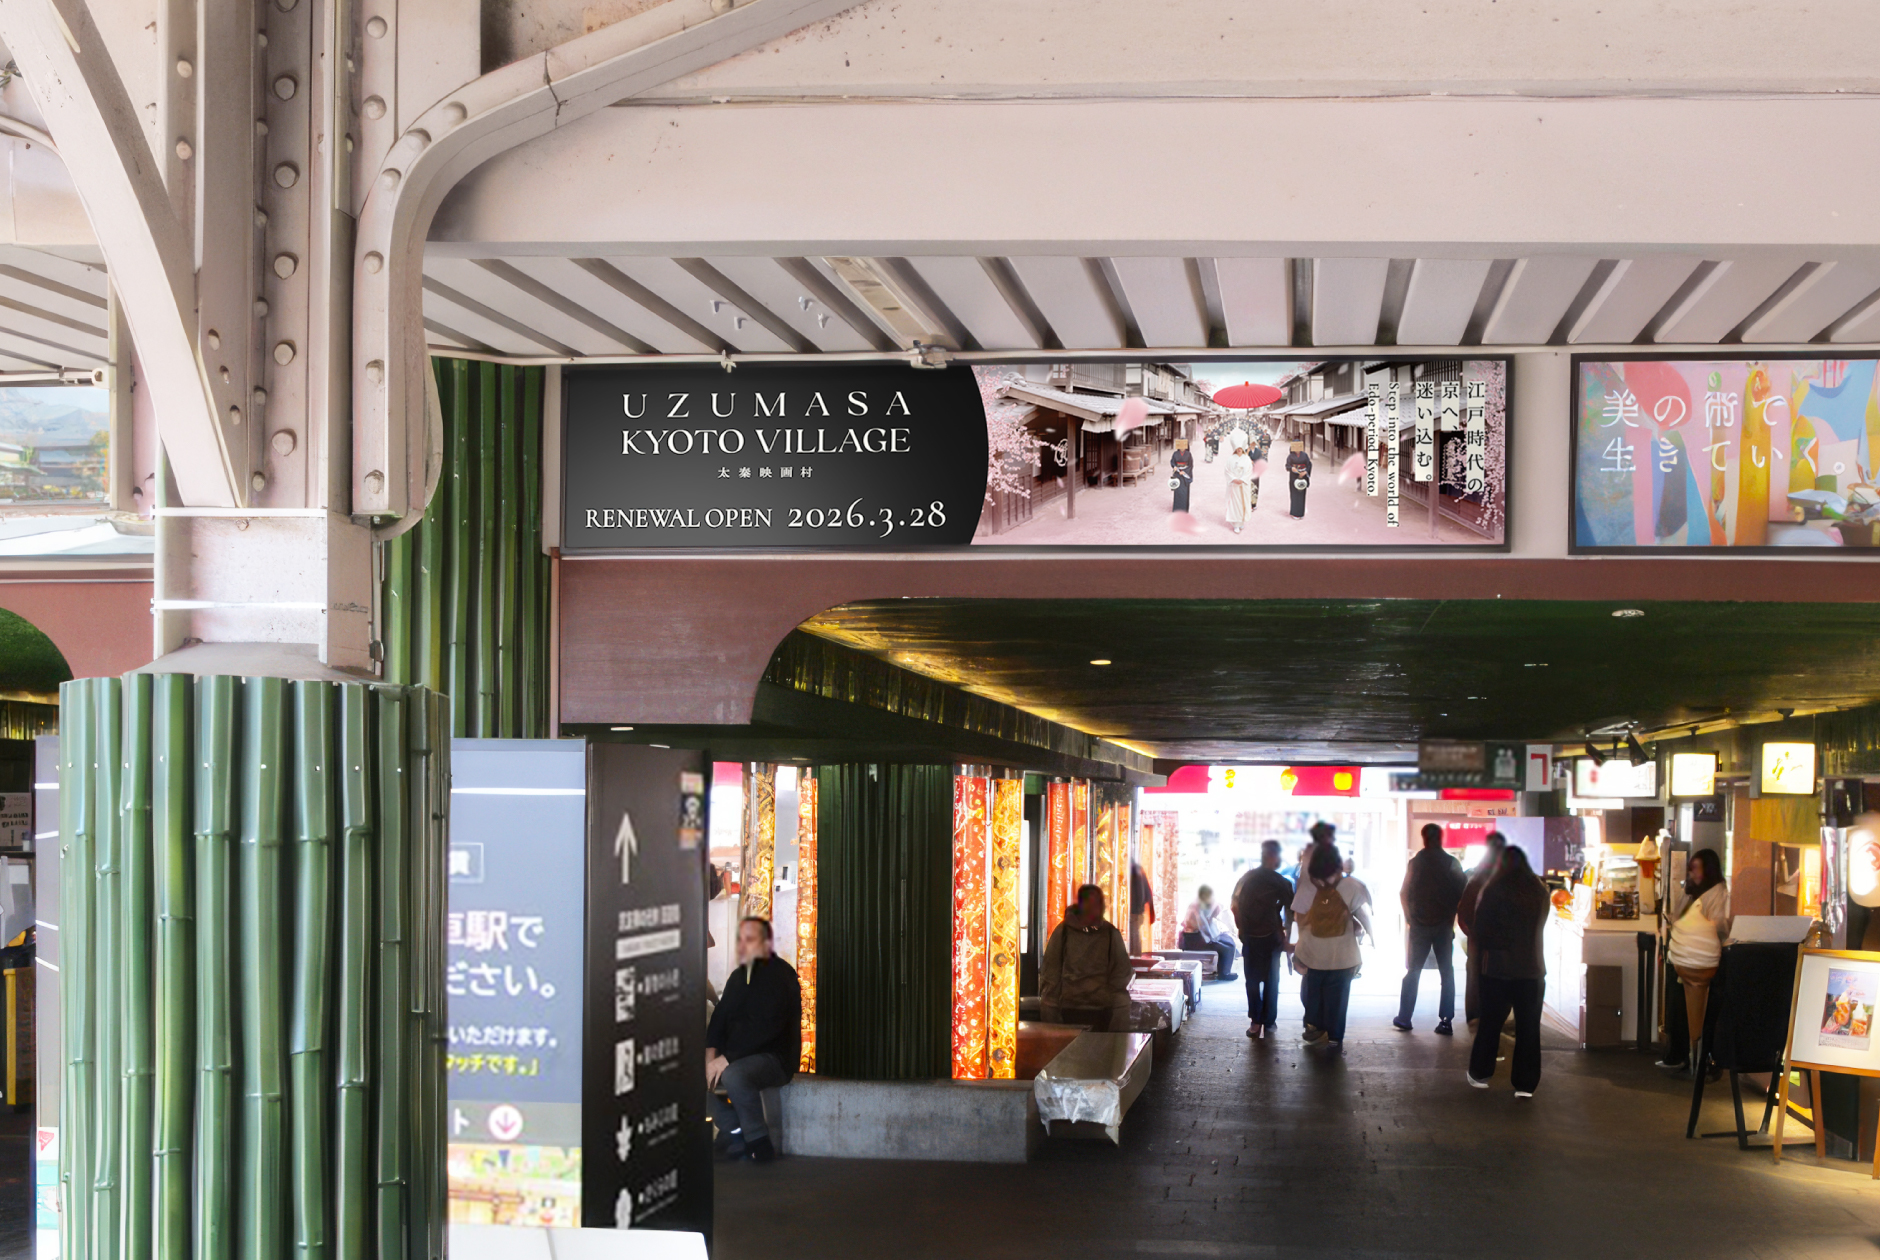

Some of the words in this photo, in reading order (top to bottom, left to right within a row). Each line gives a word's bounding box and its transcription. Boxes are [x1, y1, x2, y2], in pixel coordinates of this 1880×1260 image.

[621, 390, 911, 418] UZUMASA
[1385, 382, 1400, 411] Step
[1442, 382, 1459, 432] 京へ、
[1365, 383, 1380, 453] Edo-period
[1388, 417, 1399, 442] into
[1416, 382, 1433, 481] 迷い込む。
[621, 427, 745, 455] KYOTO
[755, 427, 911, 454] VILLAGE
[1467, 382, 1485, 492] 江戸時代の
[717, 465, 814, 479] 太秦映画村
[1388, 446, 1400, 467] the
[1364, 458, 1379, 496] Kyoto.
[1387, 471, 1400, 507] world
[585, 507, 701, 529] RENEWAL
[704, 507, 773, 529] OPEN
[787, 497, 947, 538] 2026.3.28
[1387, 512, 1400, 527] of
